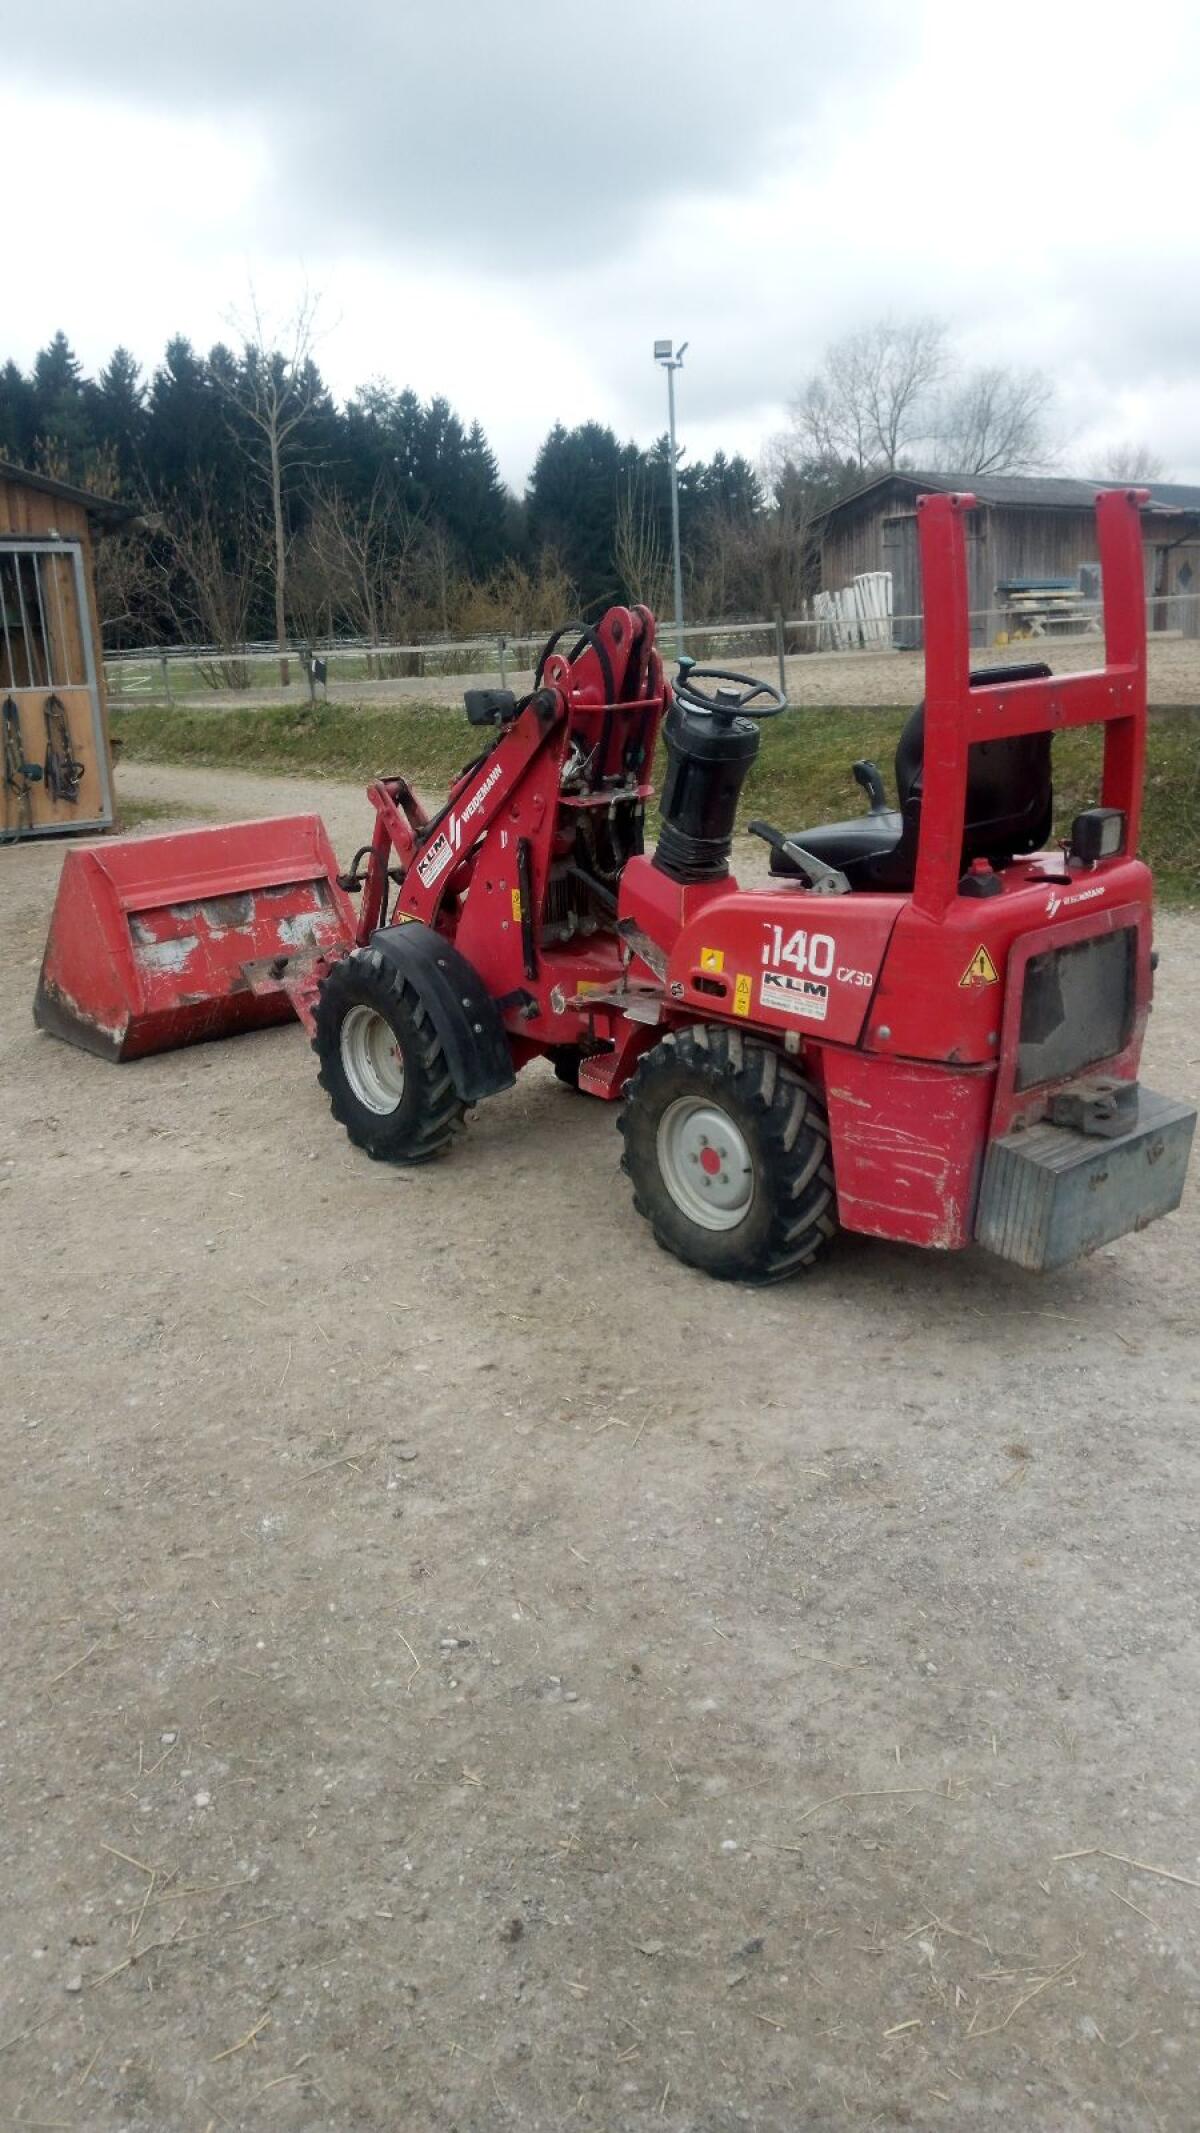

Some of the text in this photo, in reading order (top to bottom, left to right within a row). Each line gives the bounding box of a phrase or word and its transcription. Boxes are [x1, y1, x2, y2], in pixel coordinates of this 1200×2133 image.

[461, 763, 502, 823] WEIDEMANN
[418, 835, 446, 874] KLM
[764, 973, 827, 997] KLM
